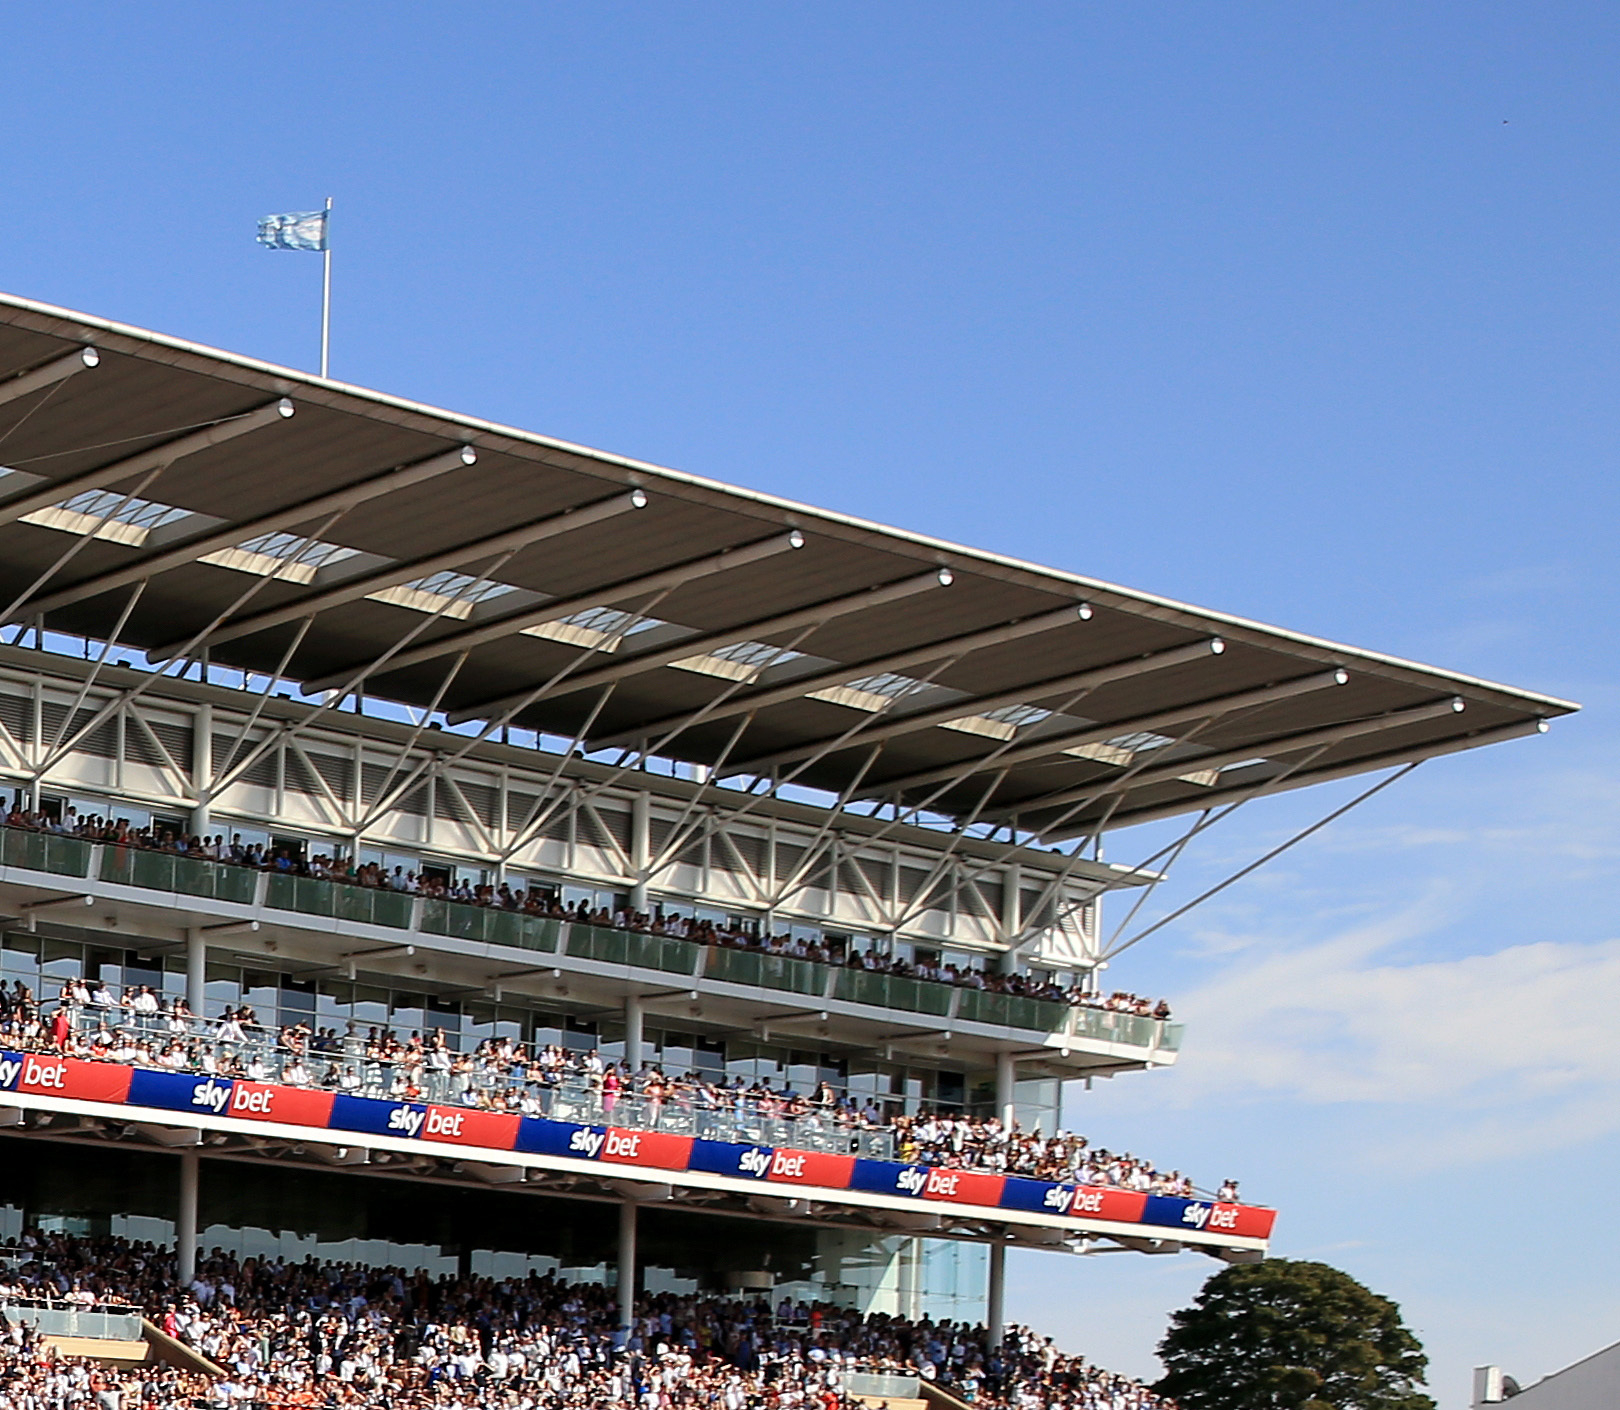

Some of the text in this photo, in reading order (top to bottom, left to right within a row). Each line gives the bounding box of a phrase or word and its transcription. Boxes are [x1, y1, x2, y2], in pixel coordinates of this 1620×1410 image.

[24, 1058, 68, 1088] bet
[192, 1079, 275, 1113] sky bet
[388, 1104, 465, 1136] sky bet
[569, 1126, 641, 1158] sky bet
[738, 1147, 807, 1178] sky bet
[896, 1166, 960, 1196] sky bet
[1043, 1185, 1105, 1213] sky bet
[1181, 1201, 1239, 1229] sky bet
